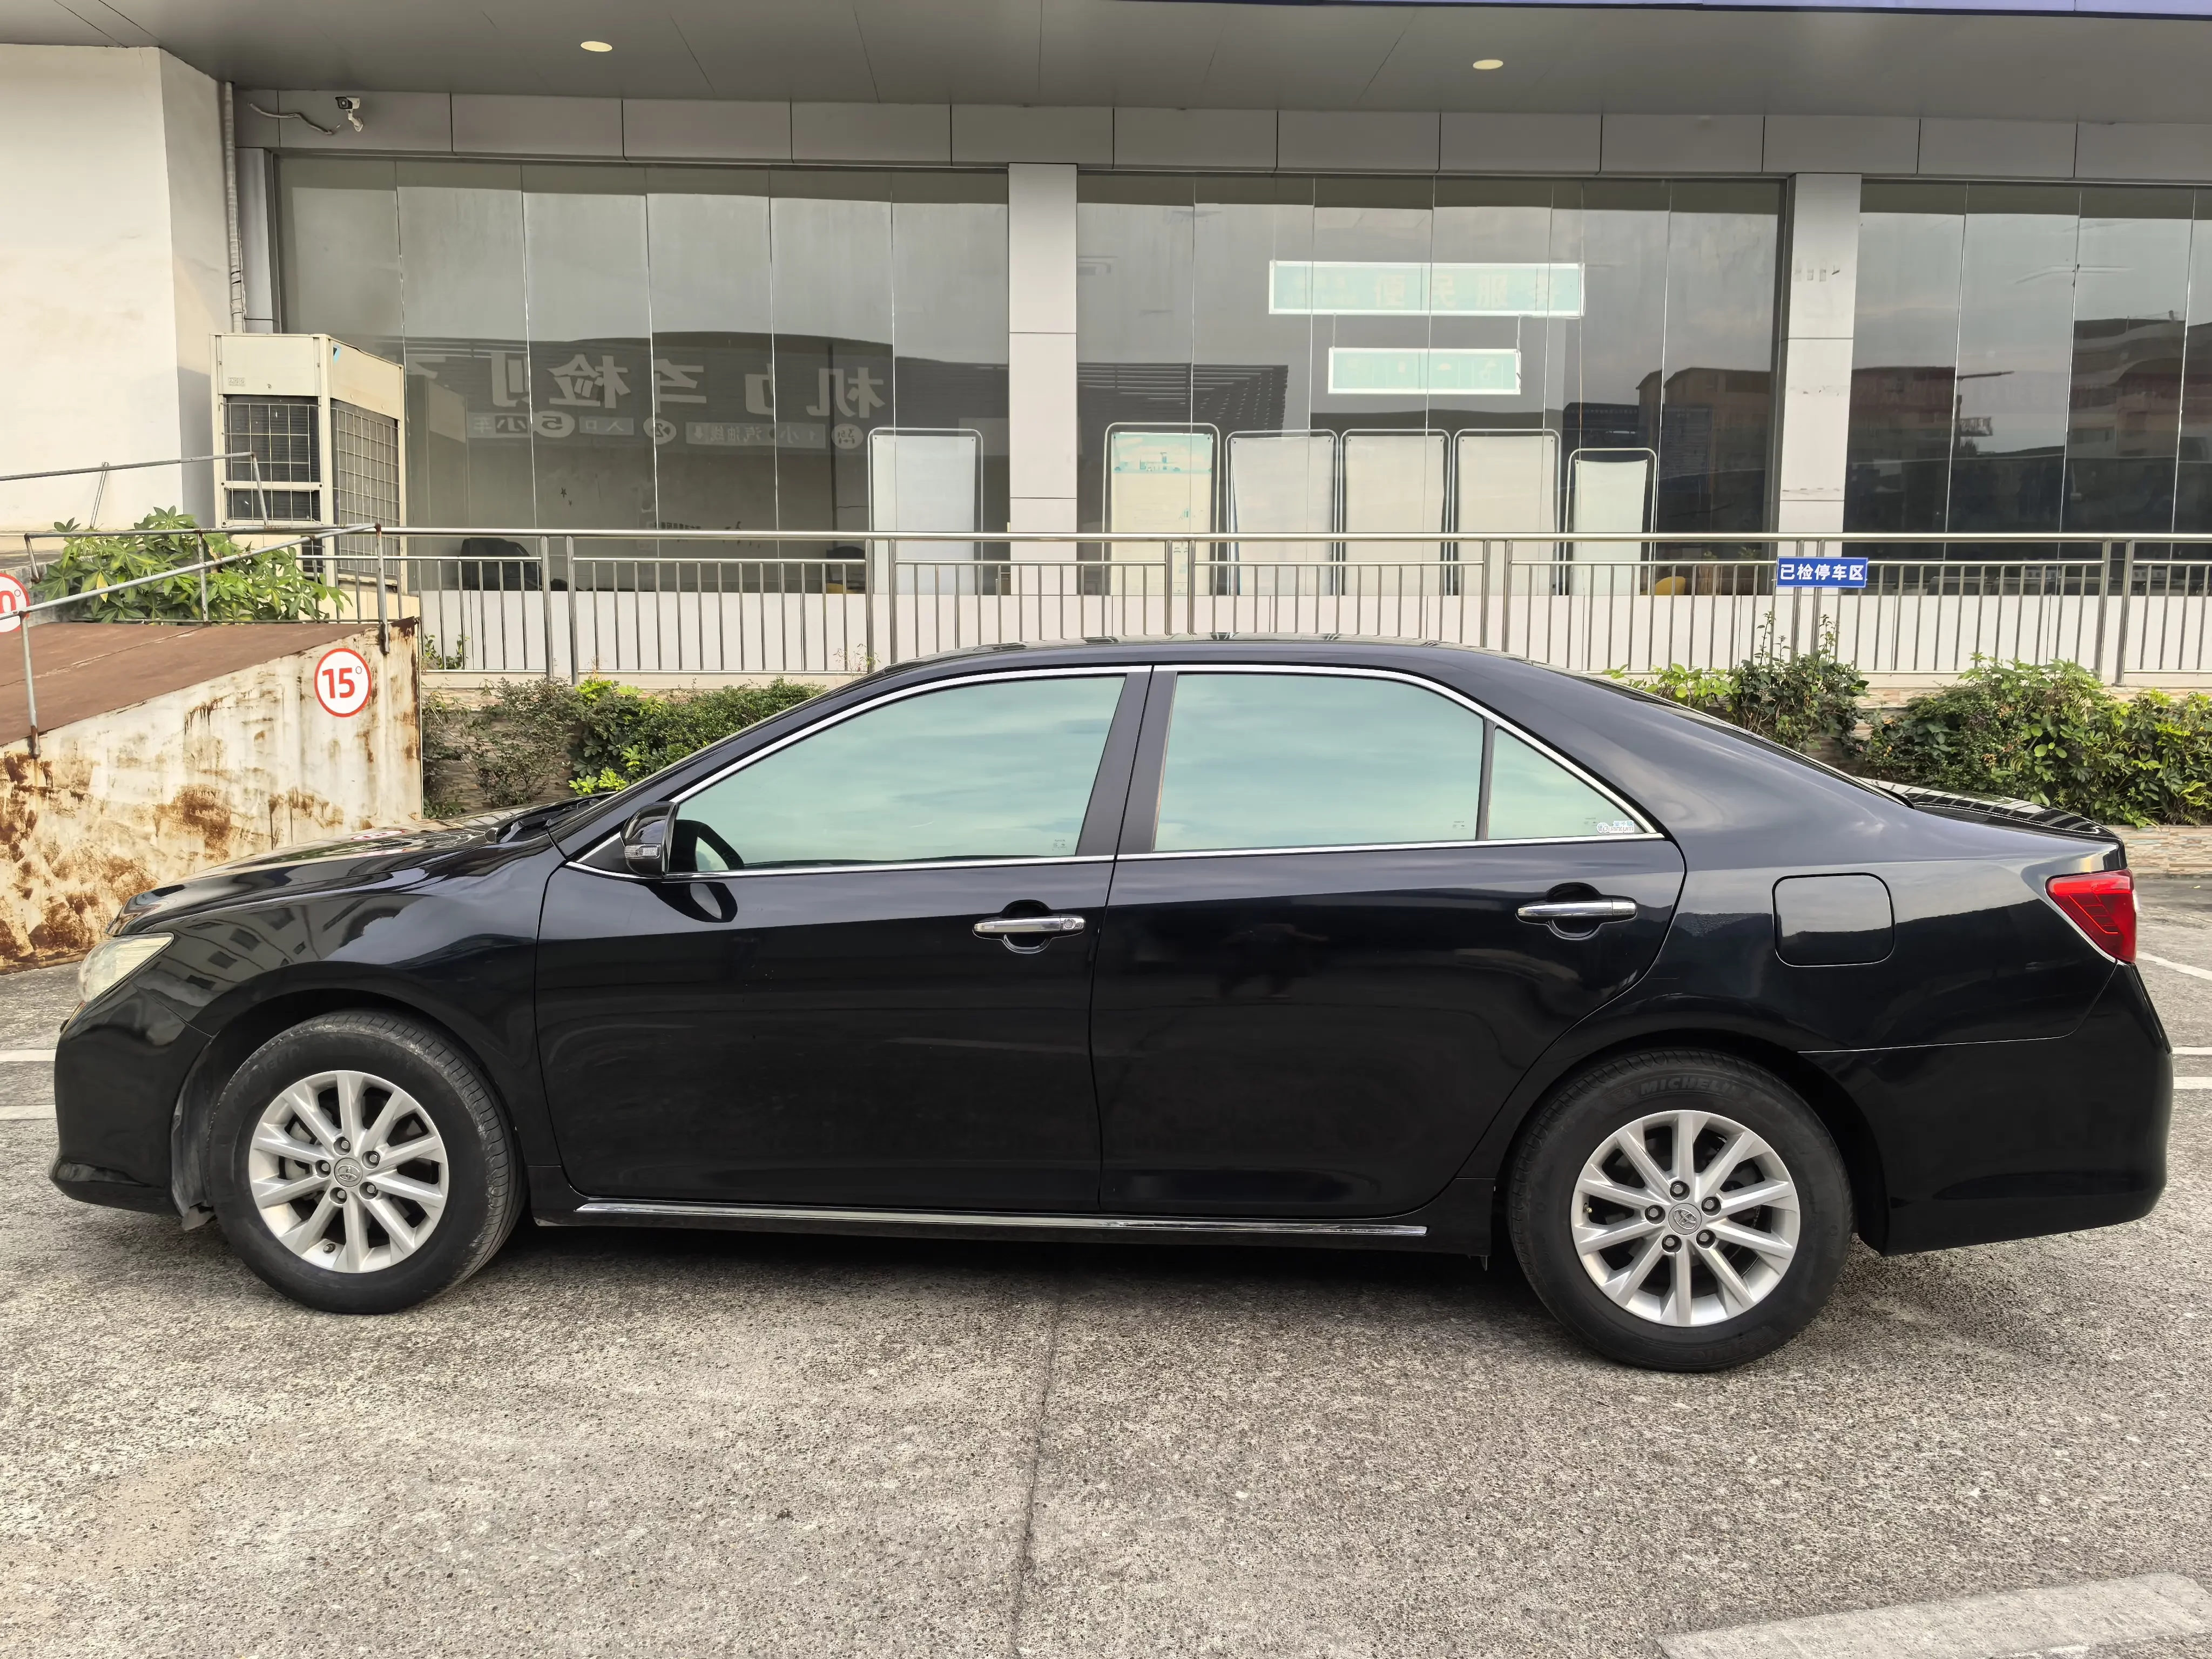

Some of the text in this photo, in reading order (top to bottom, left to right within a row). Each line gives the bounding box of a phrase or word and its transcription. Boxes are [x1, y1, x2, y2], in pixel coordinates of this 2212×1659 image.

[1373, 273, 1560, 308] 便民服务
[1780, 563, 1864, 581] 已检停车区
[1641, 1076, 1746, 1098] MICHELIN
